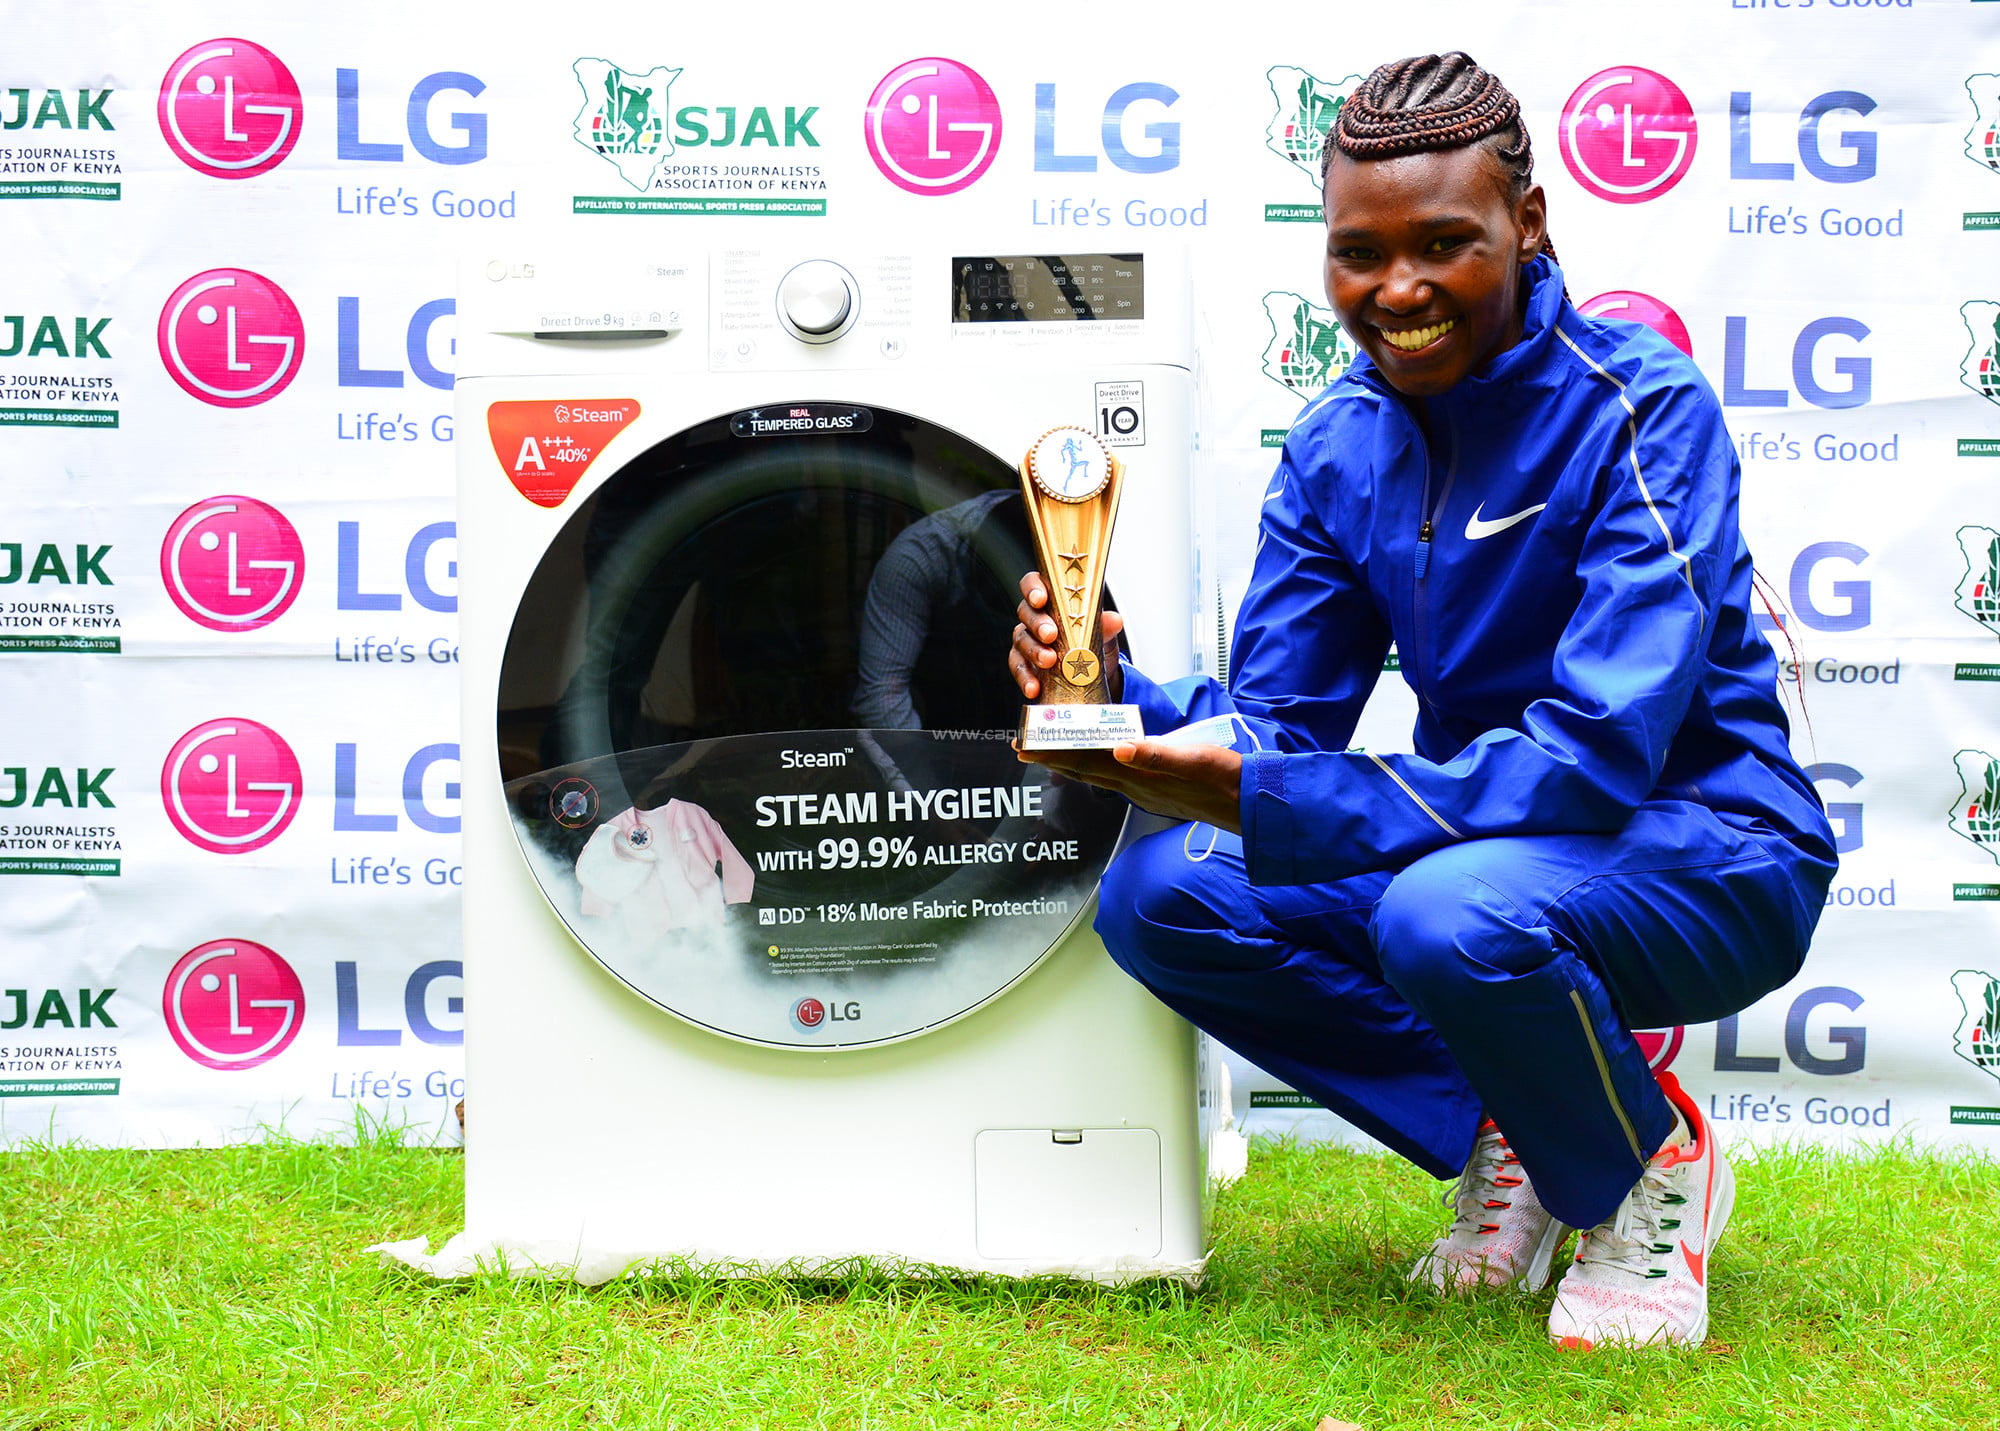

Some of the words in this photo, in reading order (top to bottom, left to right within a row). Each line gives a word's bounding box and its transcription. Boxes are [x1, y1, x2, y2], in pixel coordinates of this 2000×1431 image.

[4, 88, 115, 130] JAK
[336, 68, 487, 165] LG
[675, 106, 821, 147] SJAK
[1034, 82, 1180, 174] LG
[1730, 90, 1878, 183] LG
[17, 149, 116, 160] JOURNALISTS
[51, 162, 67, 172] OF
[74, 163, 121, 174] KENYA
[664, 166, 717, 175] SPORTS
[724, 166, 819, 176] JOURNALISTS
[58, 186, 116, 195] ASSOCIATION
[655, 179, 752, 189] ASSOCIATION
[759, 180, 774, 189] OF
[782, 181, 826, 189] KENYA
[338, 187, 418, 216] Life's
[432, 190, 515, 218] Good
[575, 201, 623, 209] AFFILIATED
[638, 202, 704, 210] INTERNATIONAL
[767, 203, 822, 211] ASSOCIATION
[1033, 198, 1110, 226] Life's
[1125, 199, 1206, 226] Good
[1267, 209, 1314, 217] AFFILIATED
[1729, 206, 1807, 234] Life's
[1821, 209, 1902, 236] Good
[511, 264, 535, 279] LG
[656, 264, 685, 278] Steam
[1052, 264, 1067, 273] Cold
[1115, 270, 1134, 278] Temp.
[1116, 300, 1132, 309] Spin
[540, 315, 572, 328] Direct
[574, 314, 601, 327] Drive
[603, 313, 612, 326] 9
[613, 314, 625, 327] kg
[0, 316, 112, 358] JAK
[338, 297, 456, 390] LG
[1723, 316, 1872, 410] LG
[11, 376, 112, 388] JOURNALISTS
[47, 390, 65, 400] OF
[72, 391, 119, 401] KENYA
[27, 413, 54, 421] PRESS
[56, 414, 114, 422] ASSOCIATION
[751, 417, 814, 432] TEMPERED
[815, 416, 854, 429] GLASS
[788, 407, 811, 419] REAL
[1101, 406, 1139, 435] 10
[338, 413, 417, 441] Life's
[1739, 432, 1800, 463] ife's
[1815, 434, 1898, 461] Good
[0, 543, 113, 585] JAK
[337, 521, 458, 613] LG
[9, 603, 114, 614] JOURNALISTS
[49, 617, 66, 626] OF
[73, 618, 121, 627] KENYA
[59, 638, 115, 648] ASSOCIATION
[335, 637, 416, 663] Life's
[1814, 657, 1901, 685] Good
[1057, 710, 1073, 719] LG
[0, 768, 115, 808] JAK
[334, 743, 461, 833] LG
[756, 792, 877, 826] STEAM
[888, 785, 1043, 821] HYGIENE
[1803, 763, 1864, 854] G
[14, 826, 115, 837] JOURNALISTS
[53, 840, 69, 849] OF
[75, 841, 121, 850] KENYA
[755, 848, 815, 874] WITH
[817, 836, 918, 870] 99.9%
[922, 843, 1017, 868] ALLERGY
[1021, 839, 1080, 863] CARE
[61, 863, 116, 871] ASSOCIATION
[332, 857, 411, 884] Life's
[424, 857, 462, 885] Go
[759, 907, 776, 926] AI
[815, 901, 857, 925] 18%
[859, 902, 909, 922] More
[912, 898, 967, 920] Fabric
[971, 894, 1070, 917] Protection
[1, 989, 117, 1029] JAK
[335, 960, 464, 1047] LG
[831, 1002, 860, 1021] LG
[1714, 986, 1867, 1076] LG
[15, 1047, 116, 1057] JOURNALISTS
[51, 1061, 68, 1070] OF
[75, 1061, 121, 1069] KENYA
[56, 1083, 115, 1091] ASSOCIATION
[331, 1070, 413, 1099] Life's
[1252, 1095, 1300, 1103] AFFILIATED
[1711, 1094, 1790, 1122] Life's
[1805, 1097, 1890, 1126] Good
